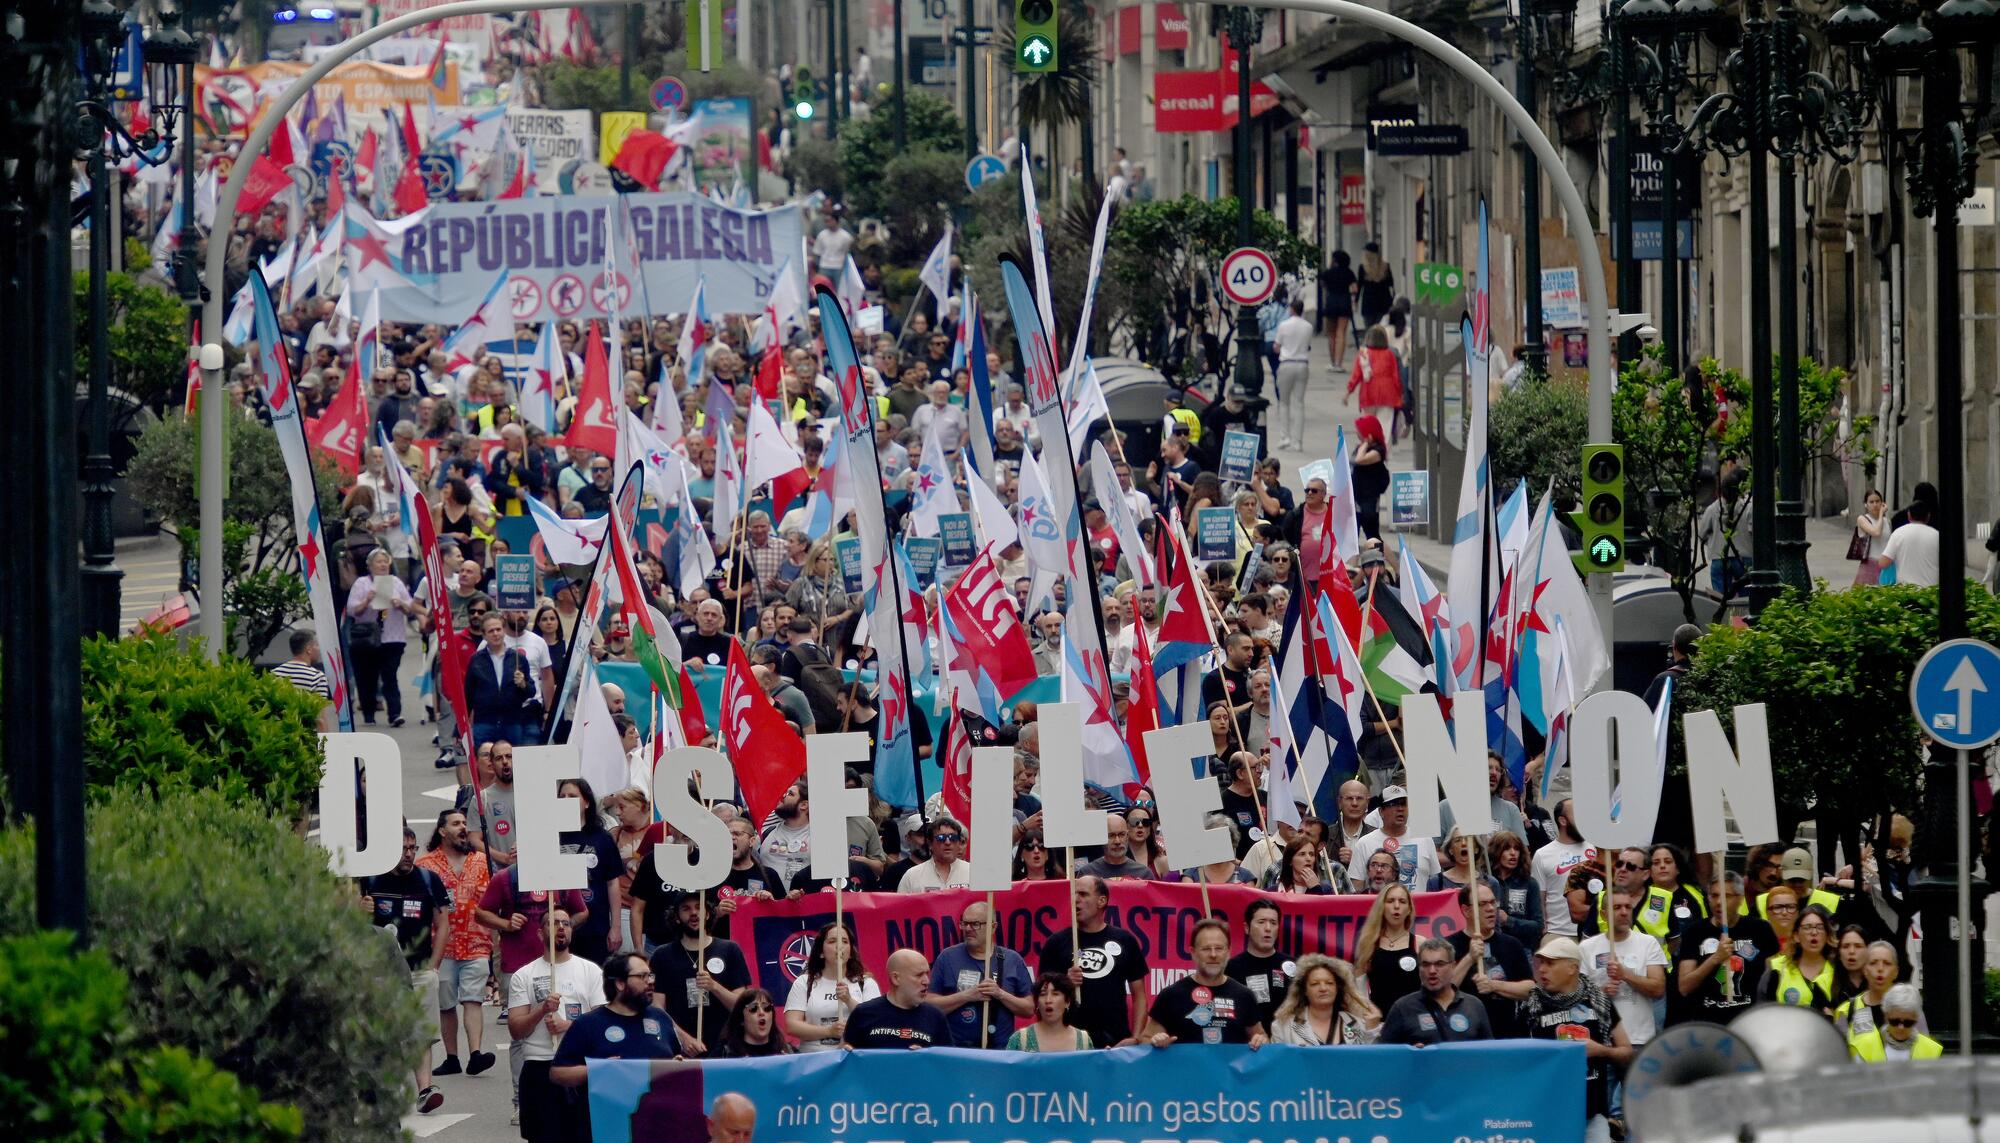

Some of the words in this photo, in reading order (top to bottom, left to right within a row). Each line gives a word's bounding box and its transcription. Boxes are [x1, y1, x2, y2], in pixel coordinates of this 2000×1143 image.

[1160, 95, 1214, 111] arenal
[508, 115, 565, 136] UERRAS
[1630, 153, 1664, 173] Ullo
[403, 205, 606, 275] REPÚBLICA
[630, 204, 775, 266] GALEGA
[1232, 266, 1263, 285] 40
[961, 553, 1016, 640] CIG
[777, 1096, 820, 1127] nin
[829, 1102, 938, 1134] guerra,
[948, 1093, 995, 1124] nin
[1005, 1091, 1096, 1126] OTAN,
[1105, 1092, 1153, 1123] nin
[1162, 1091, 1261, 1133] gastos
[1269, 1087, 1403, 1122] militares
[1483, 1119, 1533, 1129] Plataforma
